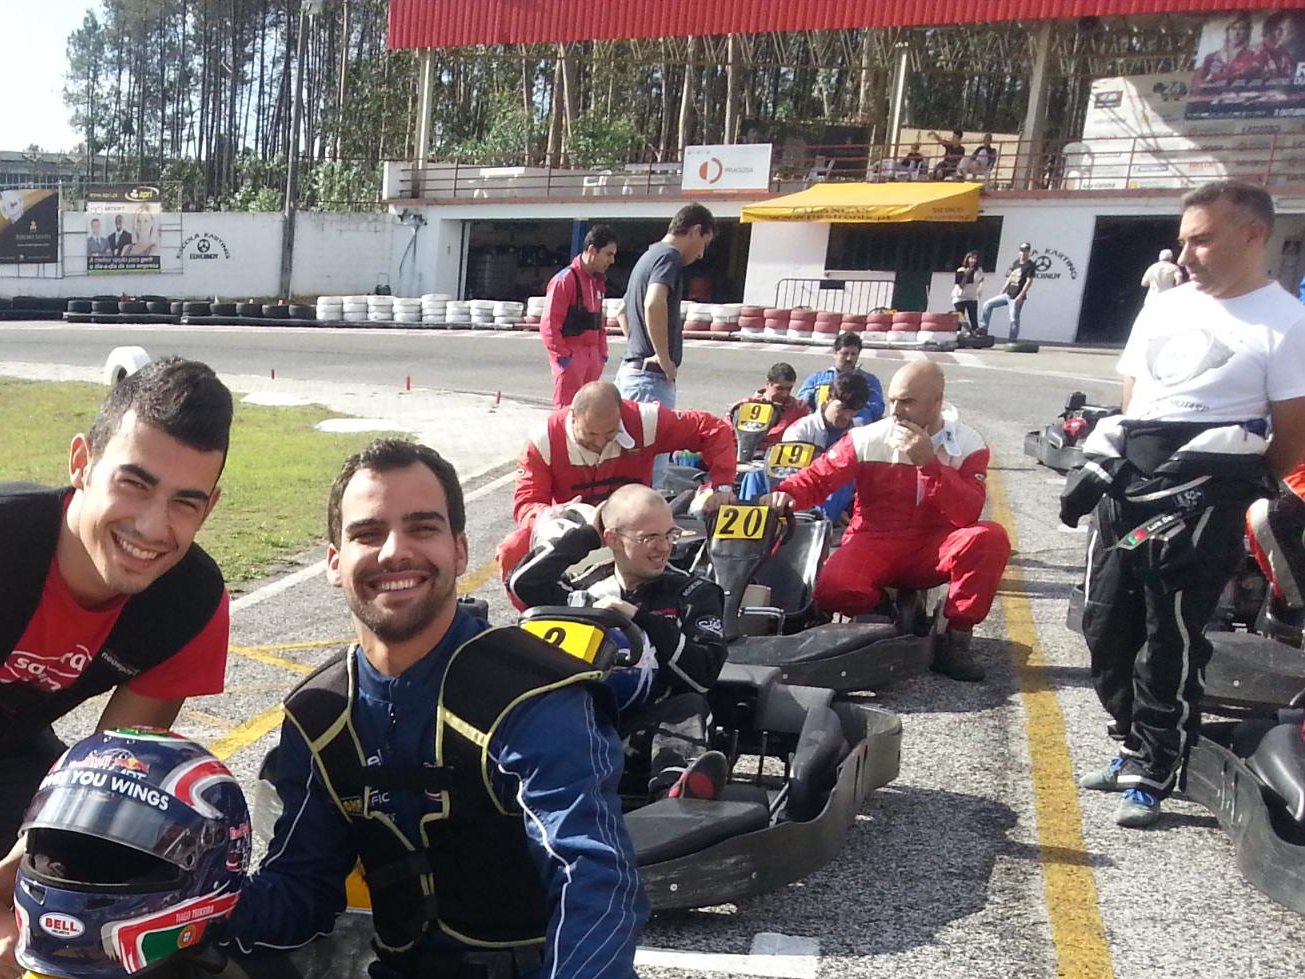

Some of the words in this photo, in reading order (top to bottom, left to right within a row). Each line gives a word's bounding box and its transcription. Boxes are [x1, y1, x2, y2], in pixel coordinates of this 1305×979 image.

[1044, 248, 1077, 280] KARTING
[750, 405, 761, 420] 9
[775, 445, 803, 465] 19
[719, 508, 763, 537] 20
[71, 770, 107, 787] YOU
[111, 776, 170, 811] WINGS
[45, 917, 78, 932] BELL
